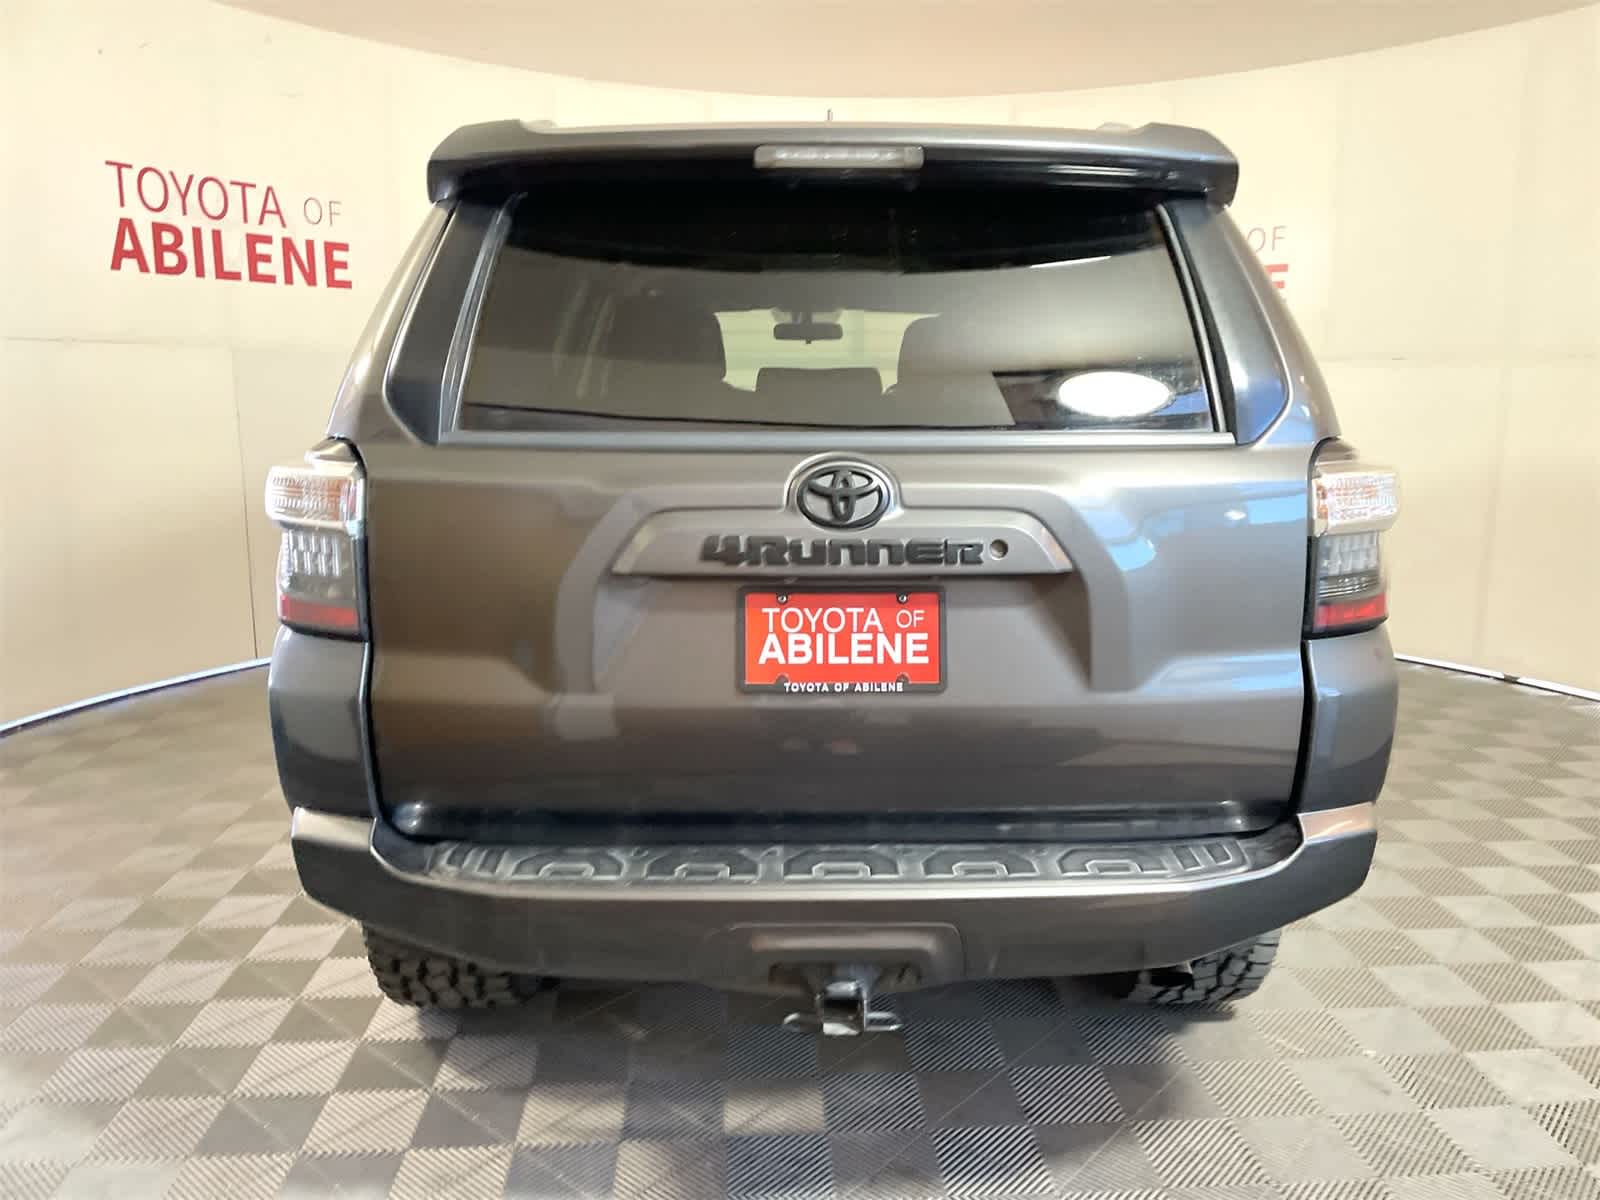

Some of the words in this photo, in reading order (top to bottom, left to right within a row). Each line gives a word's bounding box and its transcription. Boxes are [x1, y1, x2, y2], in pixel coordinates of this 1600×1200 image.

[105, 160, 287, 228] TOYOTA
[303, 197, 342, 227] OF
[110, 217, 352, 289] ABILENE
[1247, 226, 1288, 252] OF
[761, 607, 883, 633] TOYOTA
[896, 609, 925, 629] OF
[758, 632, 929, 665] ABILENE
[783, 682, 829, 693] TOYOTA
[834, 682, 850, 693] OF
[854, 682, 904, 693] ABILENE
